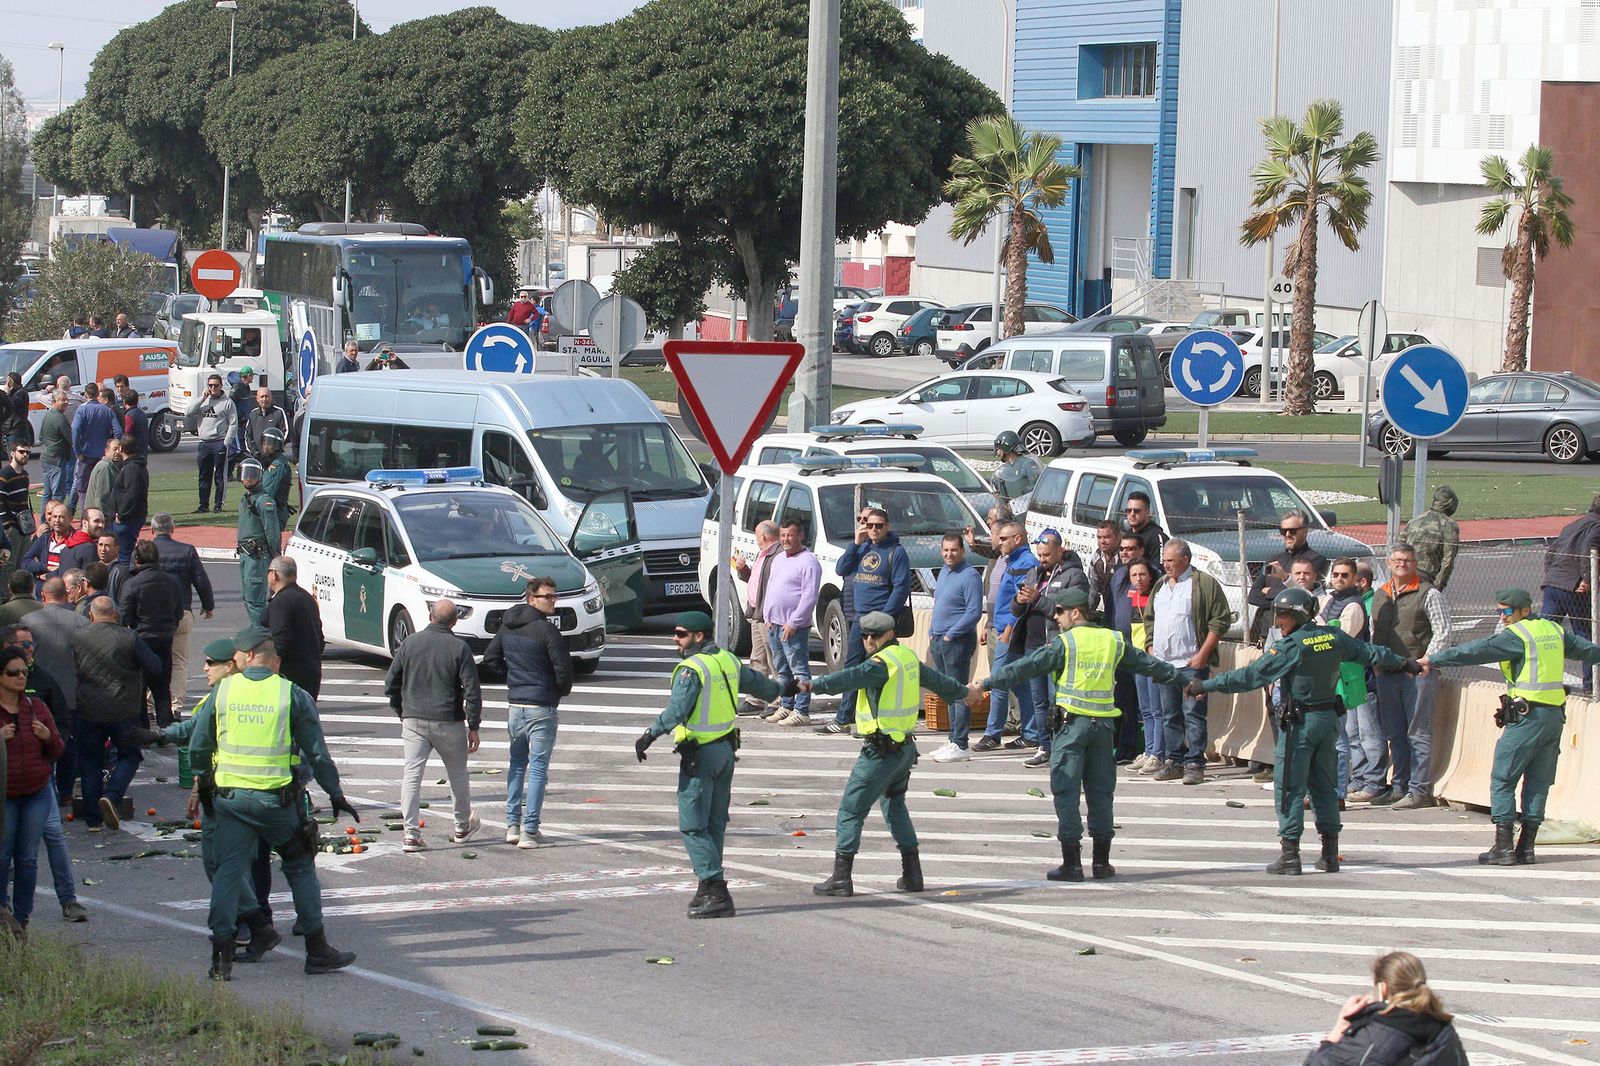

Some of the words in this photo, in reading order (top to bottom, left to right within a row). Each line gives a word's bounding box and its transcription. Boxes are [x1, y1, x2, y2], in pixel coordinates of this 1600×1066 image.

[1273, 282, 1292, 293] 40
[562, 346, 580, 354] STA.
[580, 355, 611, 363] AGUILA
[145, 361, 169, 369] SERVICE
[314, 573, 336, 588] GUARDIA
[319, 588, 331, 601] CIVIL
[1302, 633, 1336, 646] GUARDIA
[1534, 634, 1561, 643] GUARDIA
[1313, 642, 1333, 652] CIVIL
[1543, 642, 1558, 650] CIVIL
[228, 703, 276, 714] GUARDIA
[237, 714, 265, 725] CIVIL
